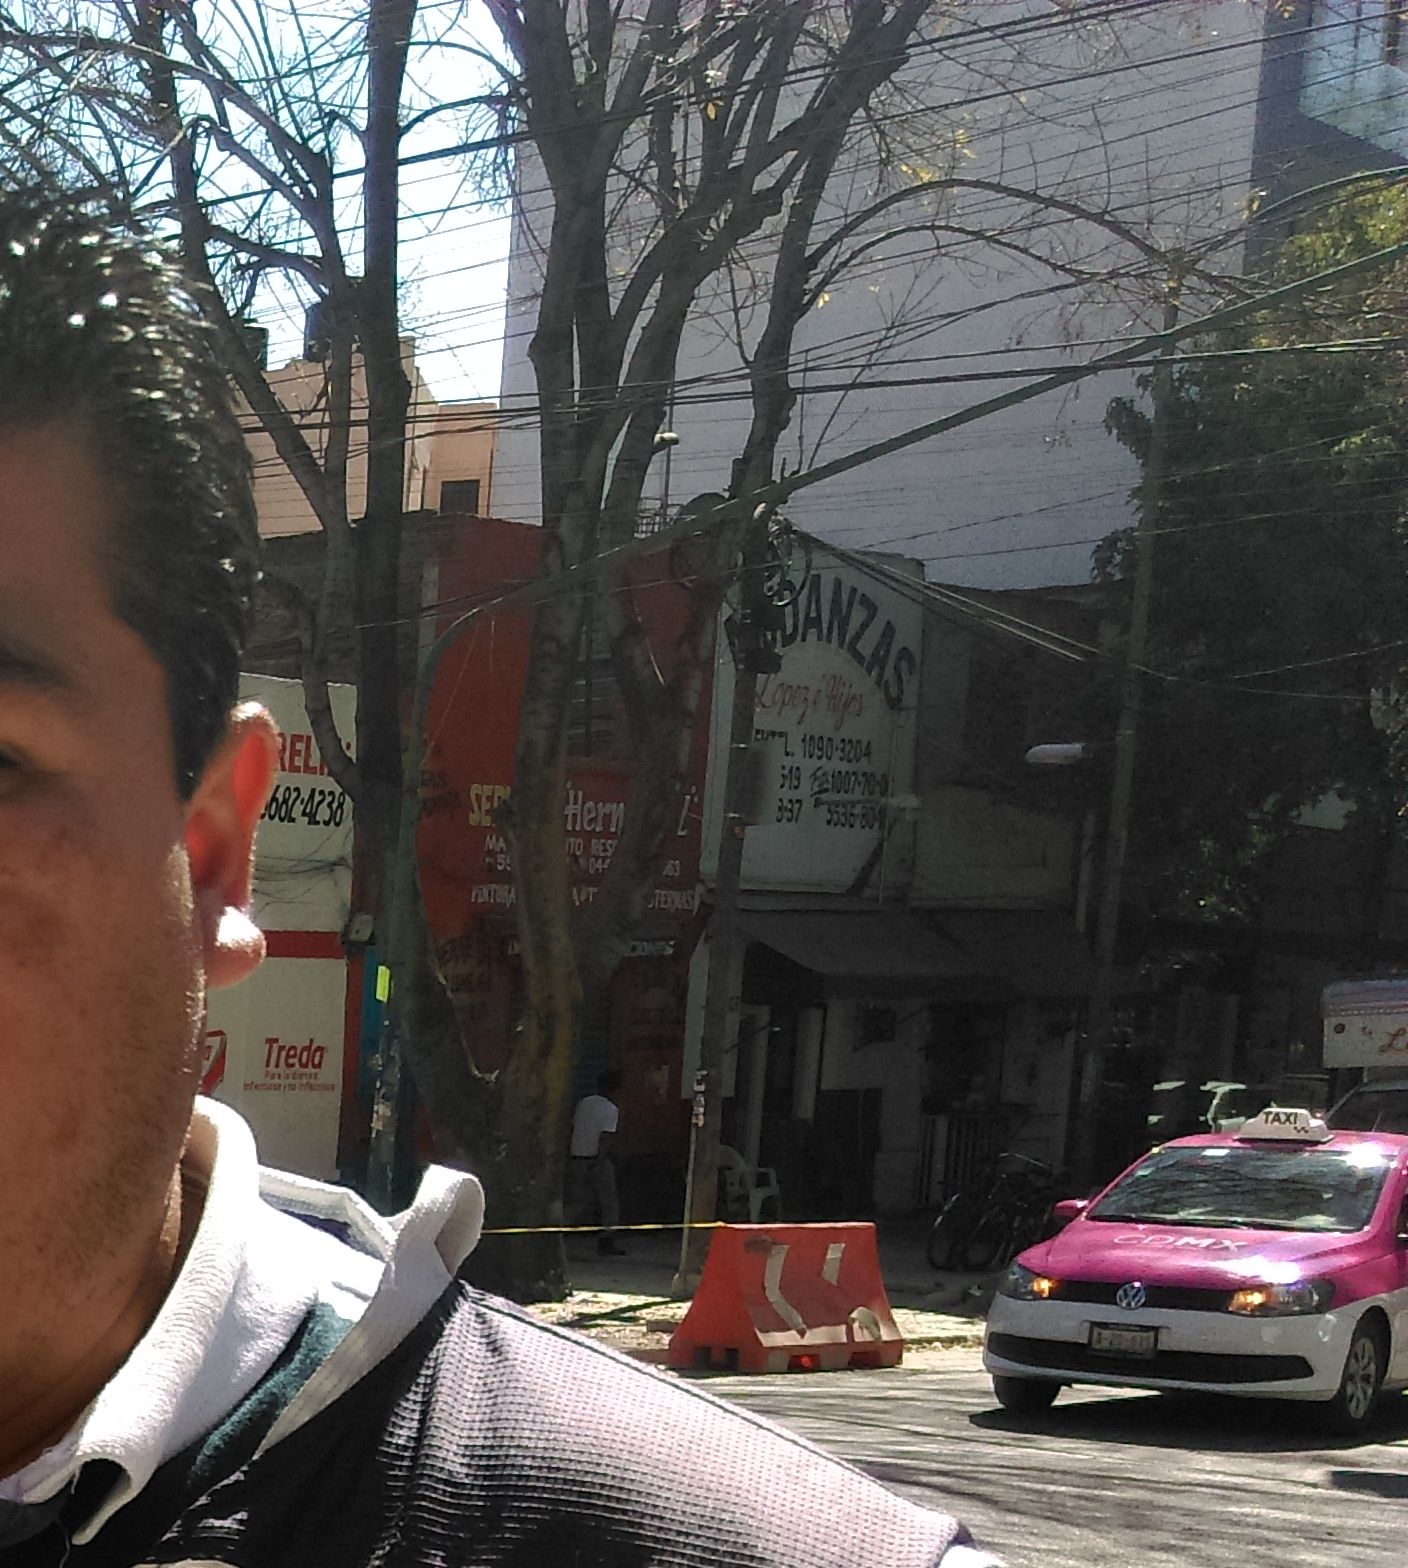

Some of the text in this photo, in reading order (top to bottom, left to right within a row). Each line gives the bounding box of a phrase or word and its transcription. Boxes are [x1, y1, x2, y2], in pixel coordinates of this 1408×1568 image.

[264, 1037, 326, 1070] Treda
[1262, 1110, 1299, 1126] TAXI
[1114, 1234, 1249, 1252] CDMX
